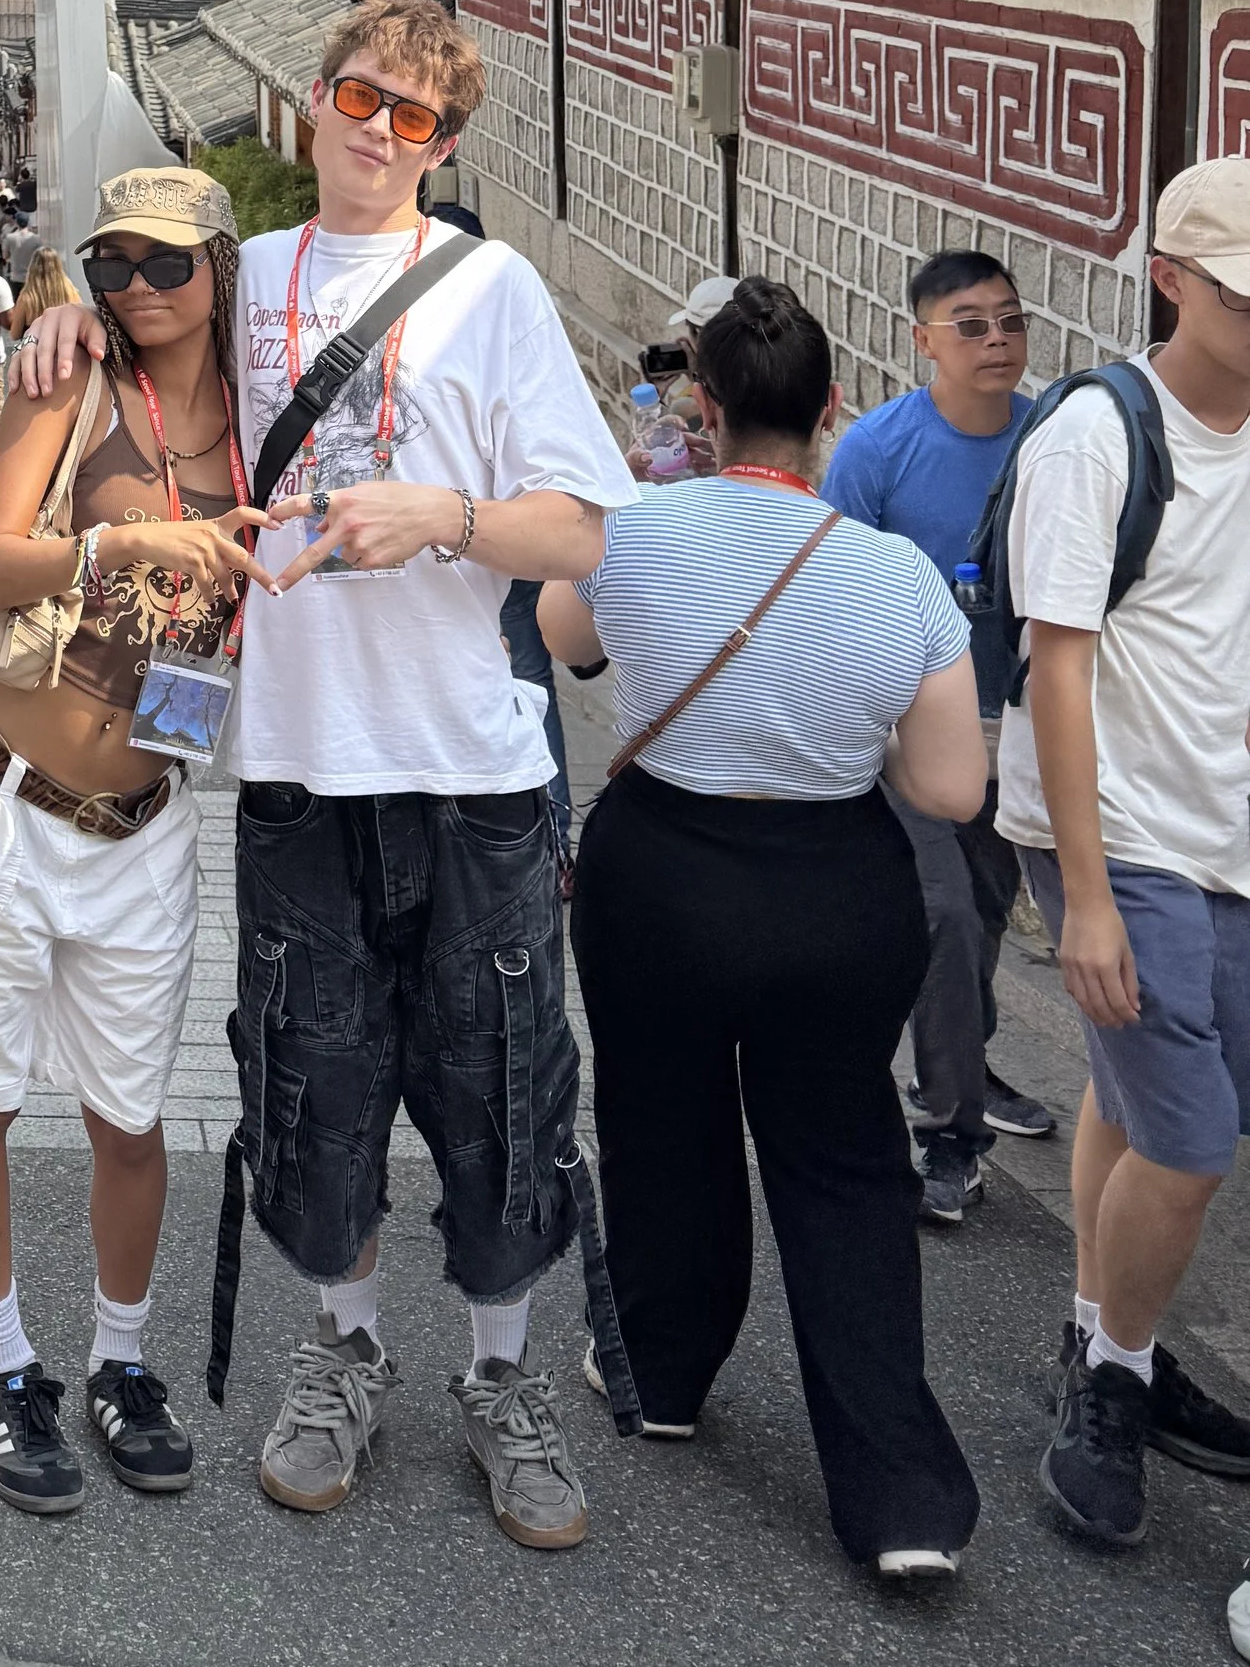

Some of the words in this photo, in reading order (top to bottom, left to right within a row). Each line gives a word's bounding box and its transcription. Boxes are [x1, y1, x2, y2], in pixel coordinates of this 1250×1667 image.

[246, 302, 341, 332] Copenagen
[246, 335, 289, 373] Jazz
[141, 379, 152, 396] Seoul
[147, 395, 156, 410] Tour
[233, 465, 242, 481] Tour
[237, 483, 246, 503] Since
